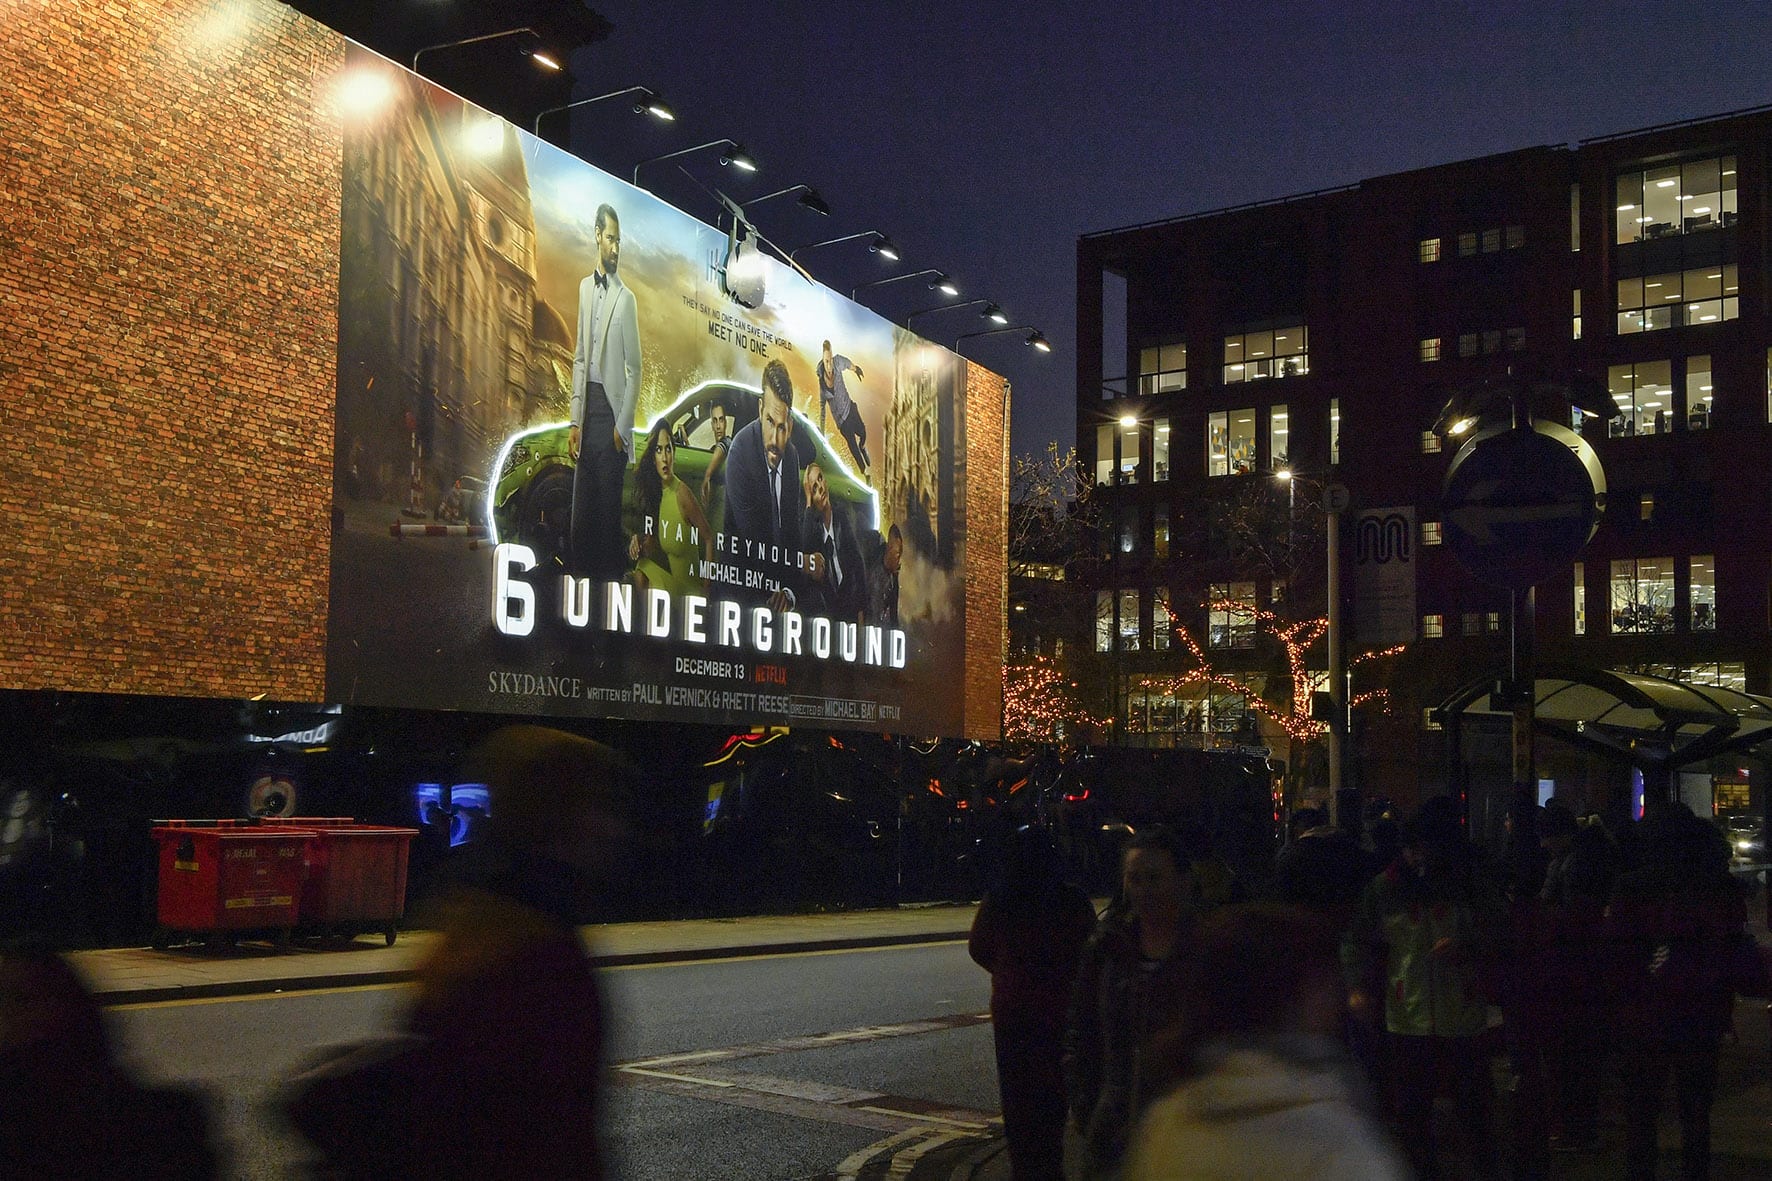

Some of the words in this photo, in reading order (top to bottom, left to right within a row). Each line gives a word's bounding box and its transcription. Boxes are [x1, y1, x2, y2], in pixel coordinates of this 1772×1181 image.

[682, 296, 698, 310] THEY
[700, 304, 711, 316] SAY
[712, 309, 721, 321] NO
[722, 313, 733, 326] ONE
[734, 318, 746, 332] CAN
[747, 324, 761, 338] SAVE
[762, 331, 773, 343] THE
[708, 320, 733, 343] MEET
[735, 331, 747, 350] NO
[750, 338, 770, 359] ONE.
[644, 516, 699, 546] RYAN
[716, 532, 816, 572] REYNOLDS
[689, 565, 695, 577] A
[700, 559, 743, 587] MICHAEL
[745, 569, 764, 591] BAY
[765, 578, 780, 593] FILM
[491, 542, 538, 637] 6
[562, 572, 906, 669] UNDERGROUND
[488, 671, 581, 699] SKYDANCE
[675, 656, 732, 679] DECEMBER
[734, 664, 745, 680] 13
[755, 664, 787, 688] NETFLIX
[587, 687, 621, 702] WRITTEN
[621, 690, 632, 703] BY
[632, 683, 663, 705] PAUL
[665, 686, 712, 709] WERNICK
[722, 691, 756, 712] RHETT
[758, 694, 789, 714] REESE
[824, 700, 860, 719] MICHAEL
[861, 703, 876, 720] BAY
[879, 705, 901, 721] NETFLIX
